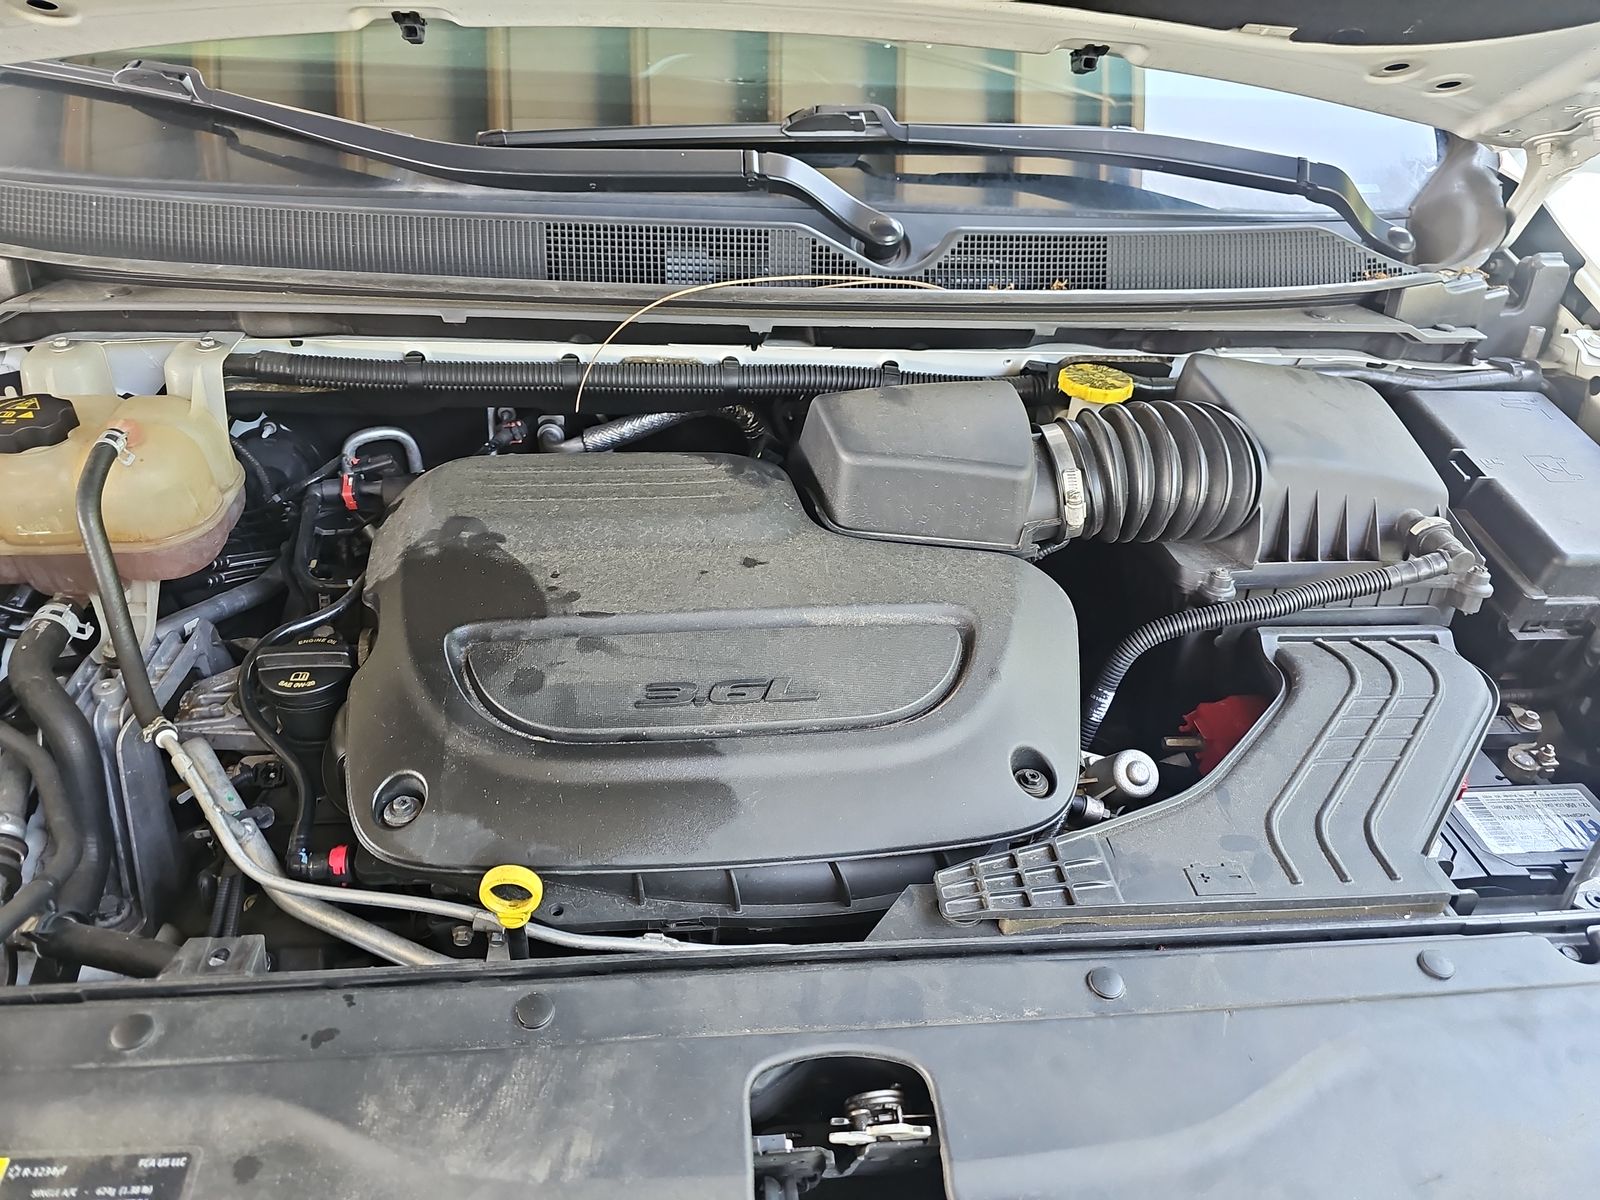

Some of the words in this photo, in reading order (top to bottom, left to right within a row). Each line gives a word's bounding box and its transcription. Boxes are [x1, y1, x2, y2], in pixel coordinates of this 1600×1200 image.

[278, 680, 292, 688] SAE
[634, 677, 821, 709] 3.6L
[139, 1157, 156, 1168] FCA
[157, 1157, 170, 1167] US
[171, 1156, 187, 1167] LLC
